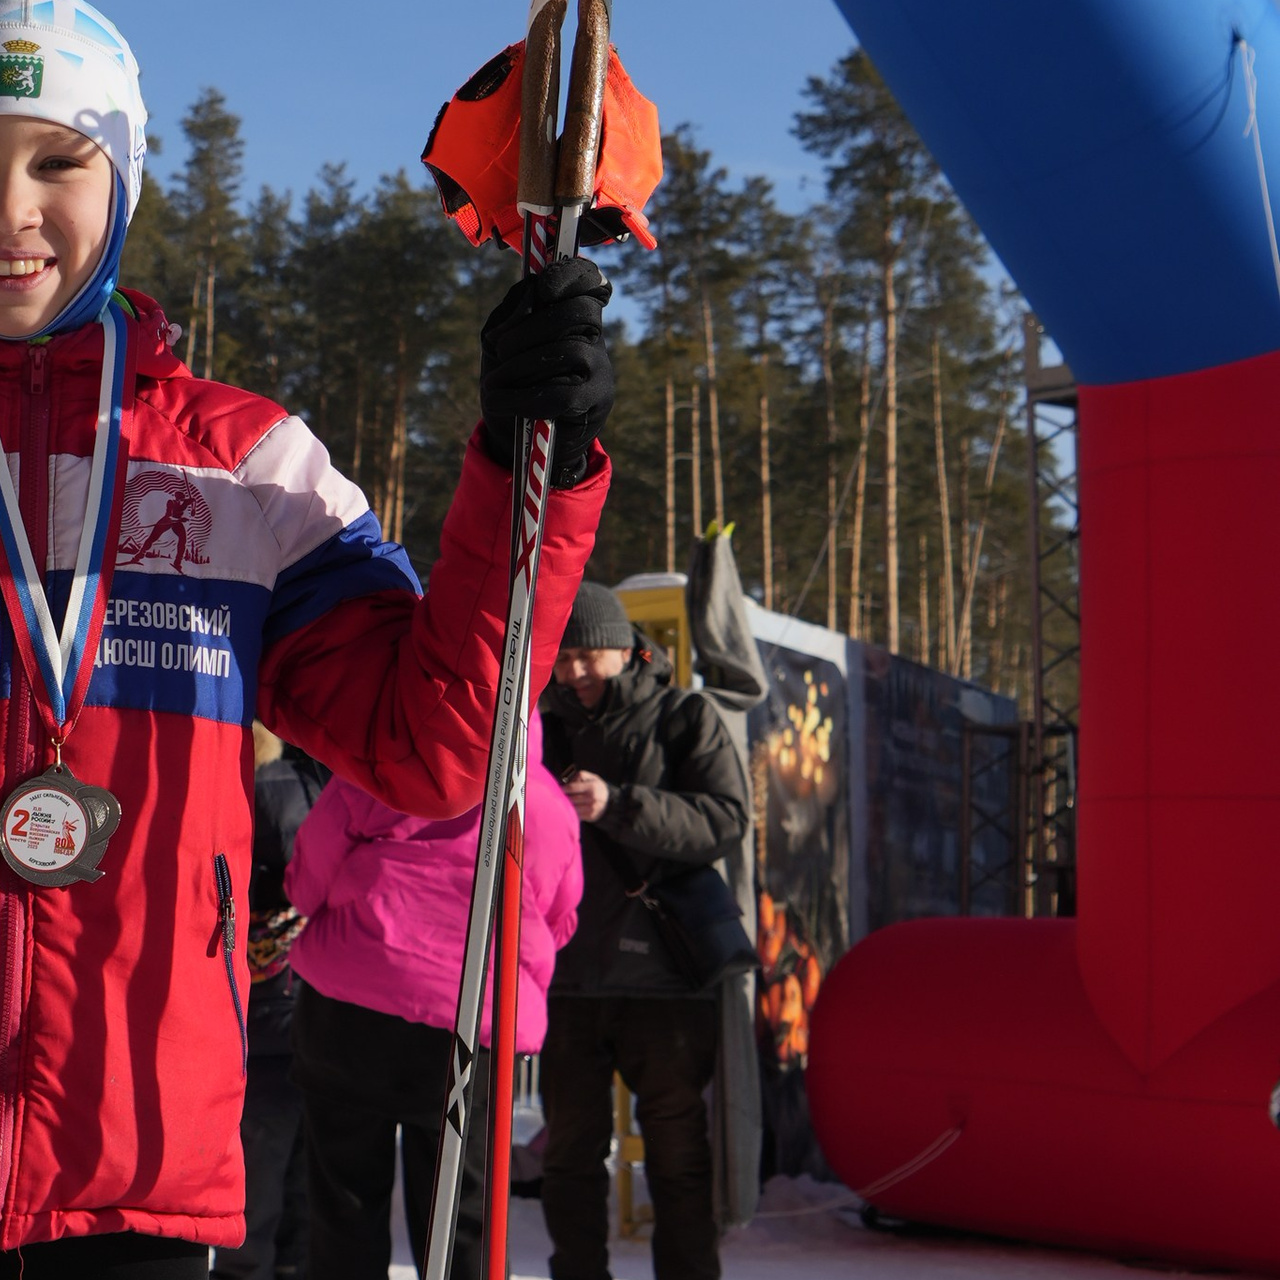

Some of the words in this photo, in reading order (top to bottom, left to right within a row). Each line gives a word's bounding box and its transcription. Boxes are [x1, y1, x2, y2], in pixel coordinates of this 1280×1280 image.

[514, 418, 553, 599] WIX
[103, 599, 231, 638] ЕРЕЗОВСКИЙ
[161, 642, 231, 678] ОЛИМП
[500, 711, 509, 736] Ultra
[497, 737, 506, 761] light
[11, 809, 29, 837] 2
[484, 798, 497, 868] performance
